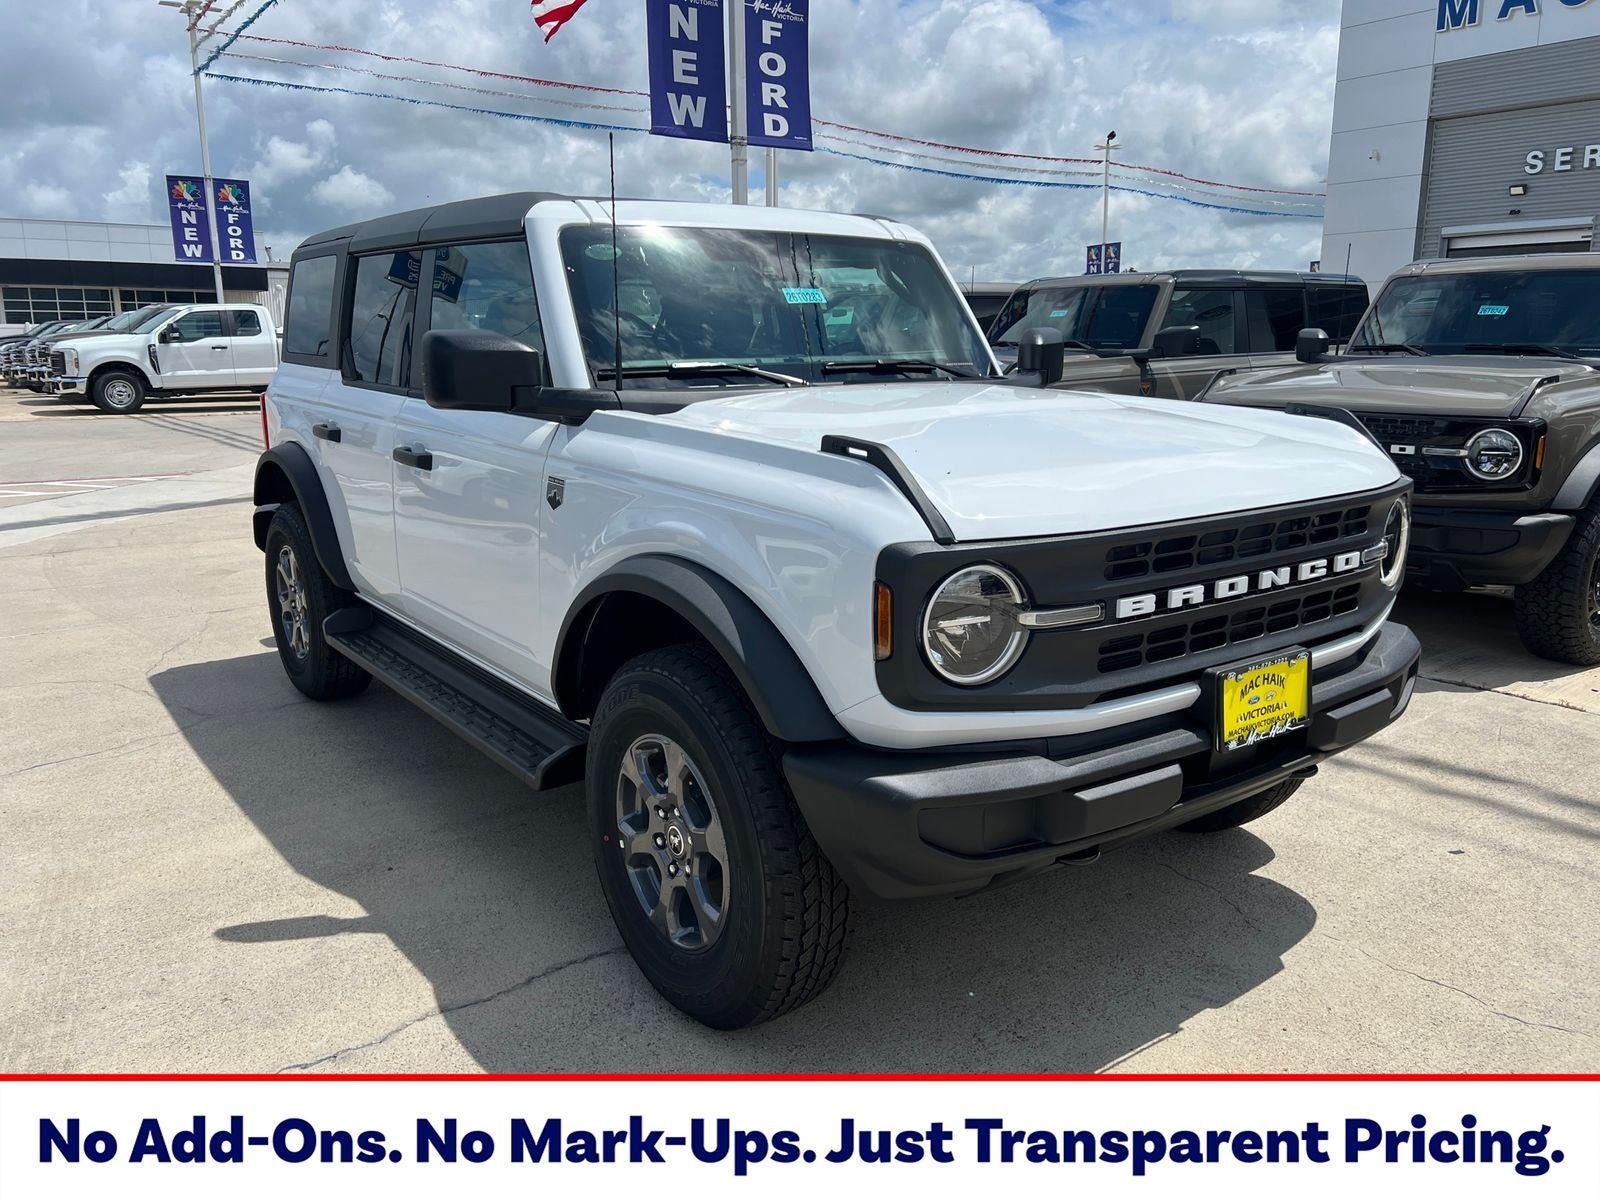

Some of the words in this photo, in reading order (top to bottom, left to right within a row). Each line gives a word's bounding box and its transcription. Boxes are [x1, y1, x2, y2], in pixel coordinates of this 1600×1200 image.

[776, 13, 804, 22] VICTORIA
[666, 4, 707, 128] NEW
[758, 19, 790, 138] FORD
[181, 210, 203, 258] NEW
[227, 213, 245, 261] FORD
[1115, 551, 1361, 619] BRONCO
[1239, 674, 1261, 702] MAC
[1262, 673, 1286, 689] HAIK
[1241, 702, 1281, 722] VICTORIA
